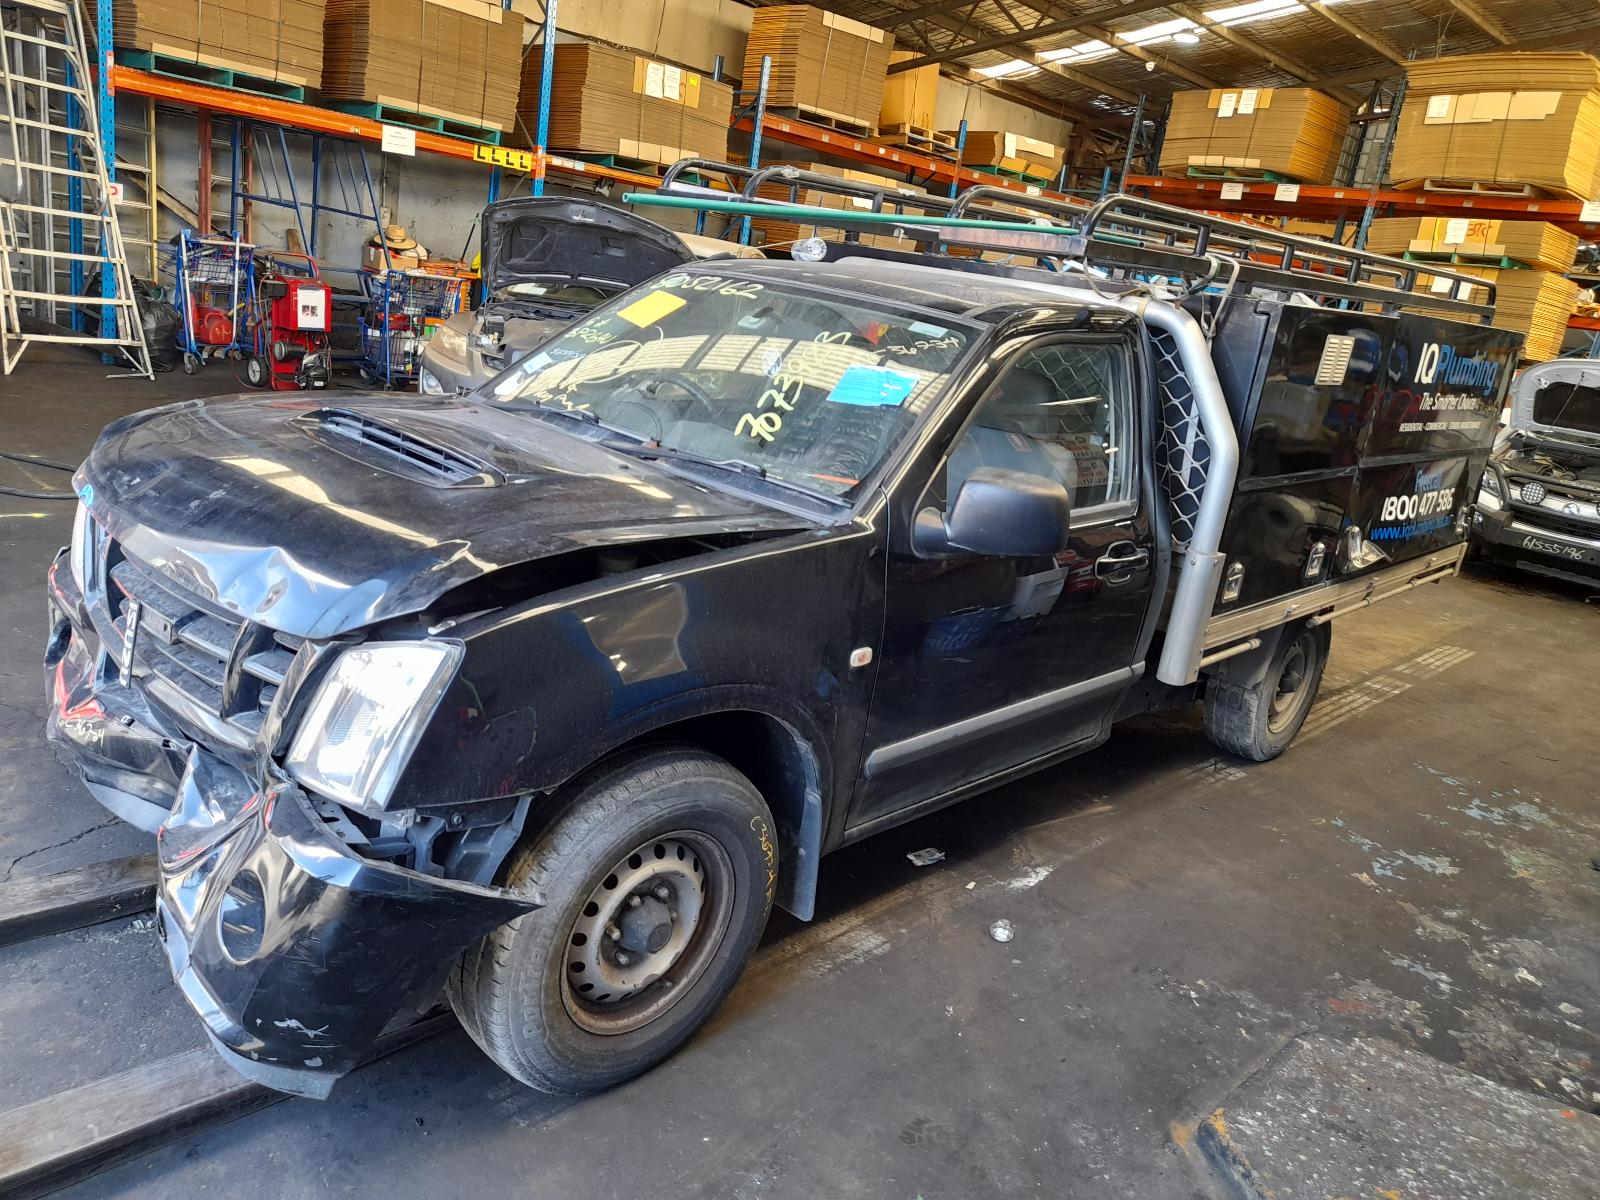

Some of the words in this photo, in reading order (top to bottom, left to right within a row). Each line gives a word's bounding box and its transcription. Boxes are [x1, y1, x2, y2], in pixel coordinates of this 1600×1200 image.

[1419, 392, 1434, 411] The
[1380, 494, 1420, 522] 1800
[1418, 490, 1439, 517] 477
[119, 601, 139, 690] ISUZU
